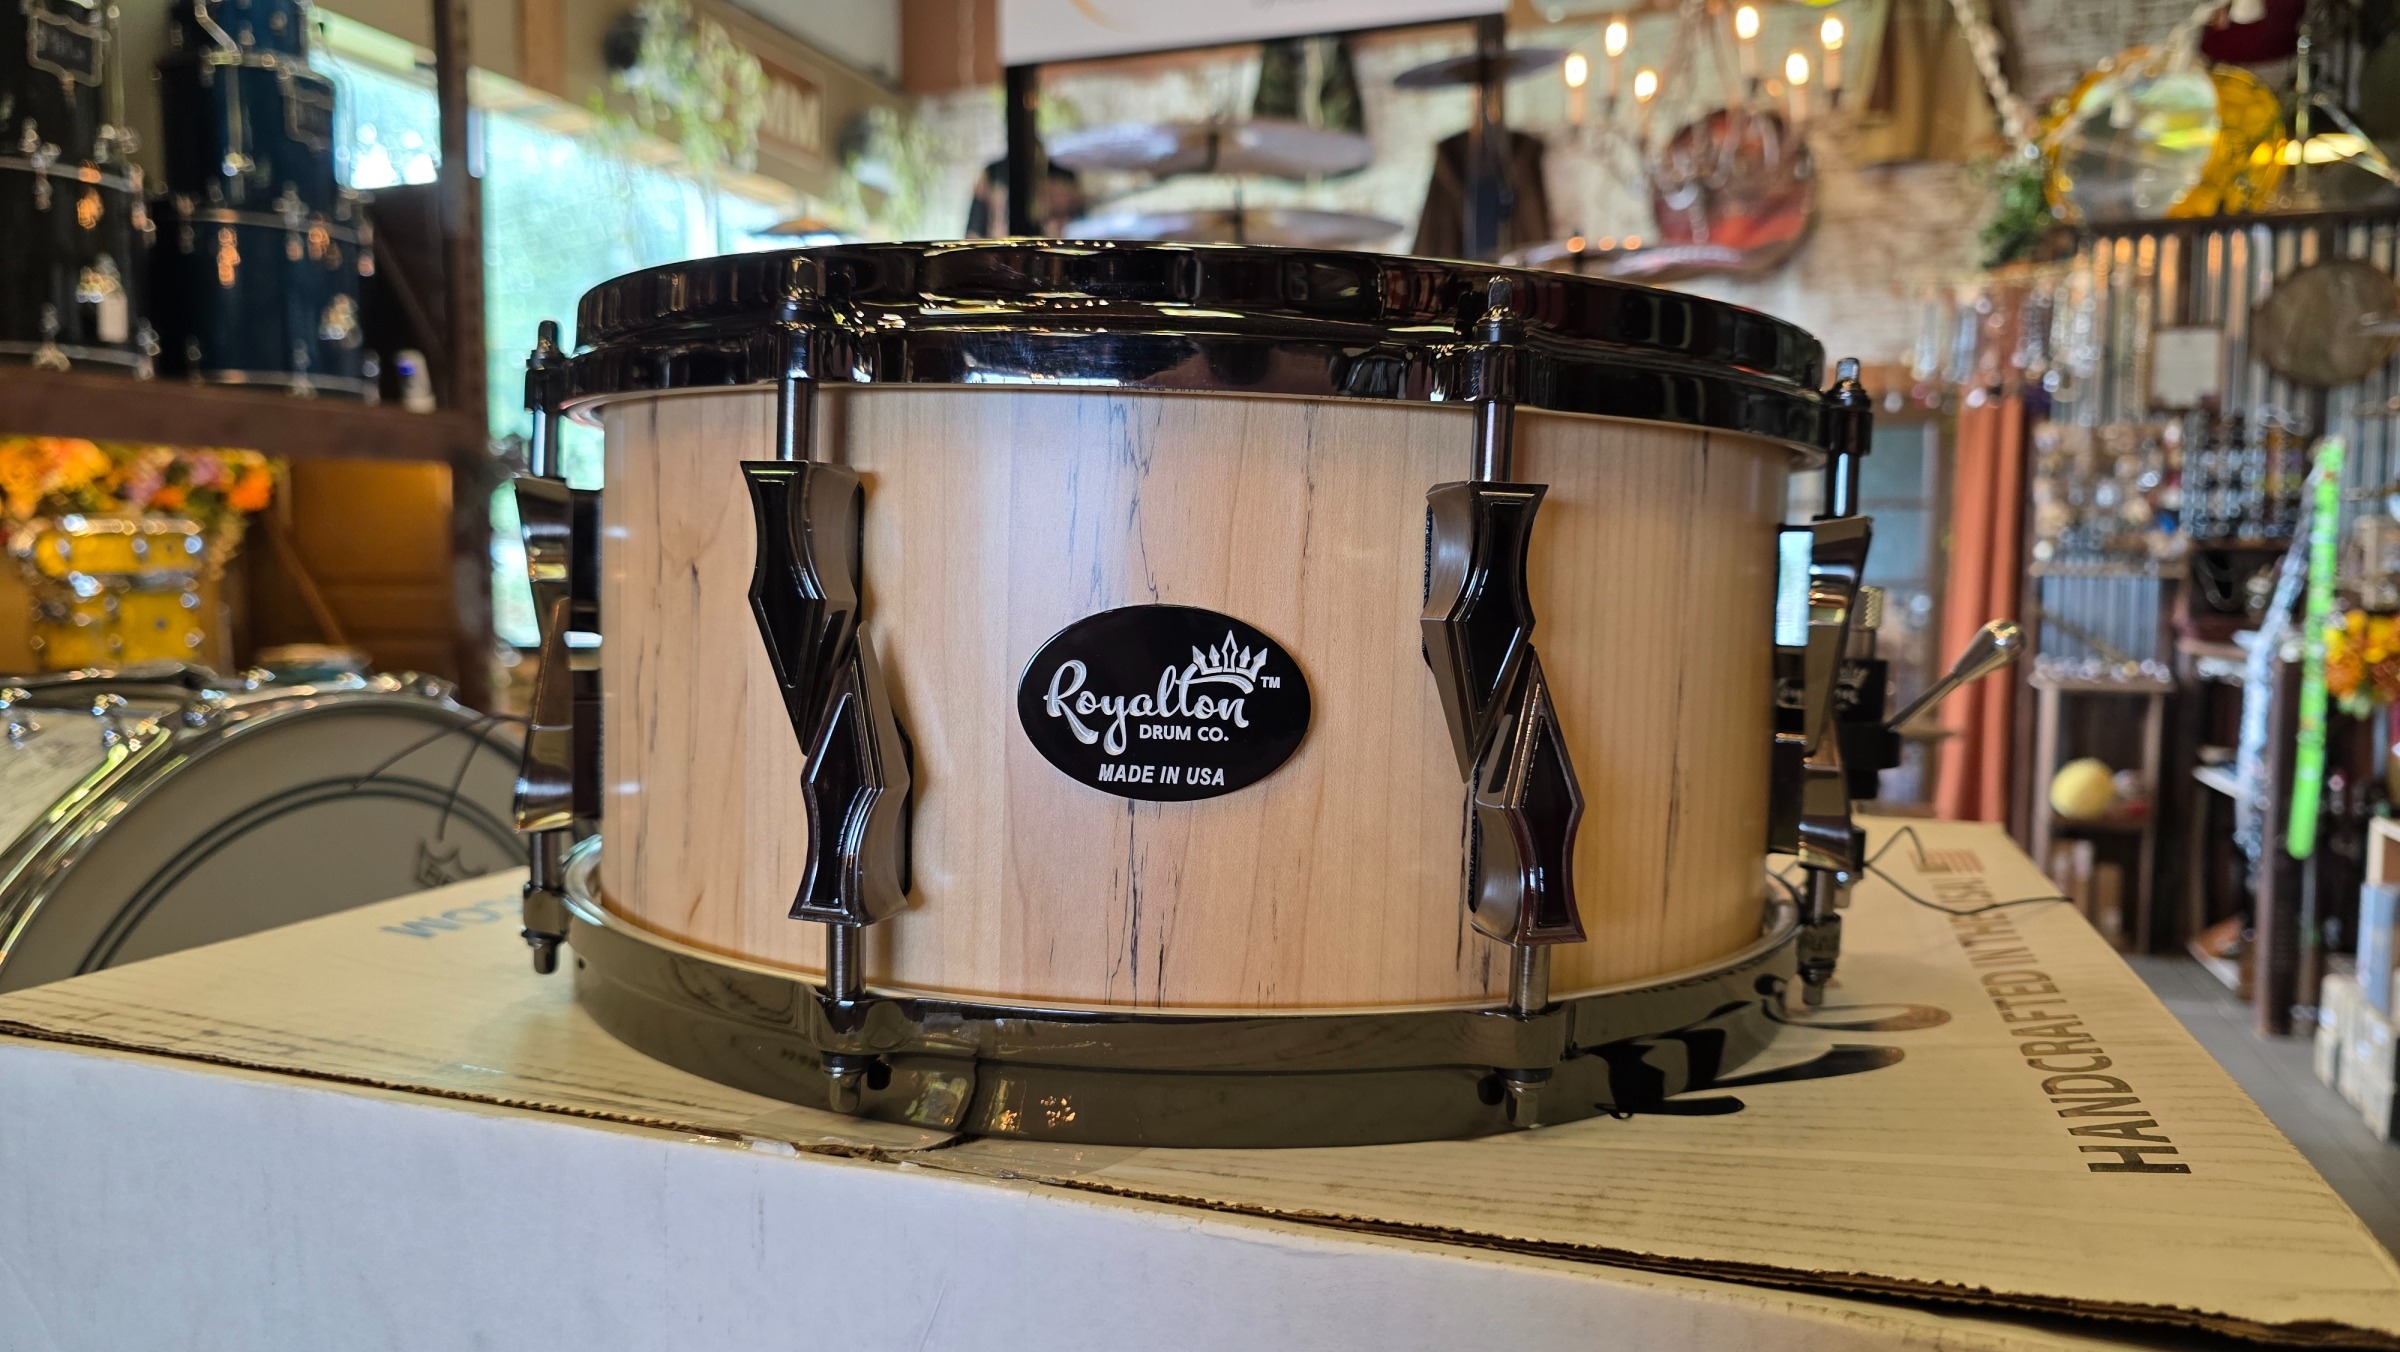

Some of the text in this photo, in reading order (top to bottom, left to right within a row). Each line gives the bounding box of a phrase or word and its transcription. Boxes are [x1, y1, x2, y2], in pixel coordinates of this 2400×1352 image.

[1043, 659, 1254, 755] Royalton
[1139, 724, 1230, 742] DRUM CO.
[1098, 763, 1225, 786] MADE IN USA
[1964, 946, 2041, 969] IN
[1980, 969, 2192, 1174] HANDCRAFTED
